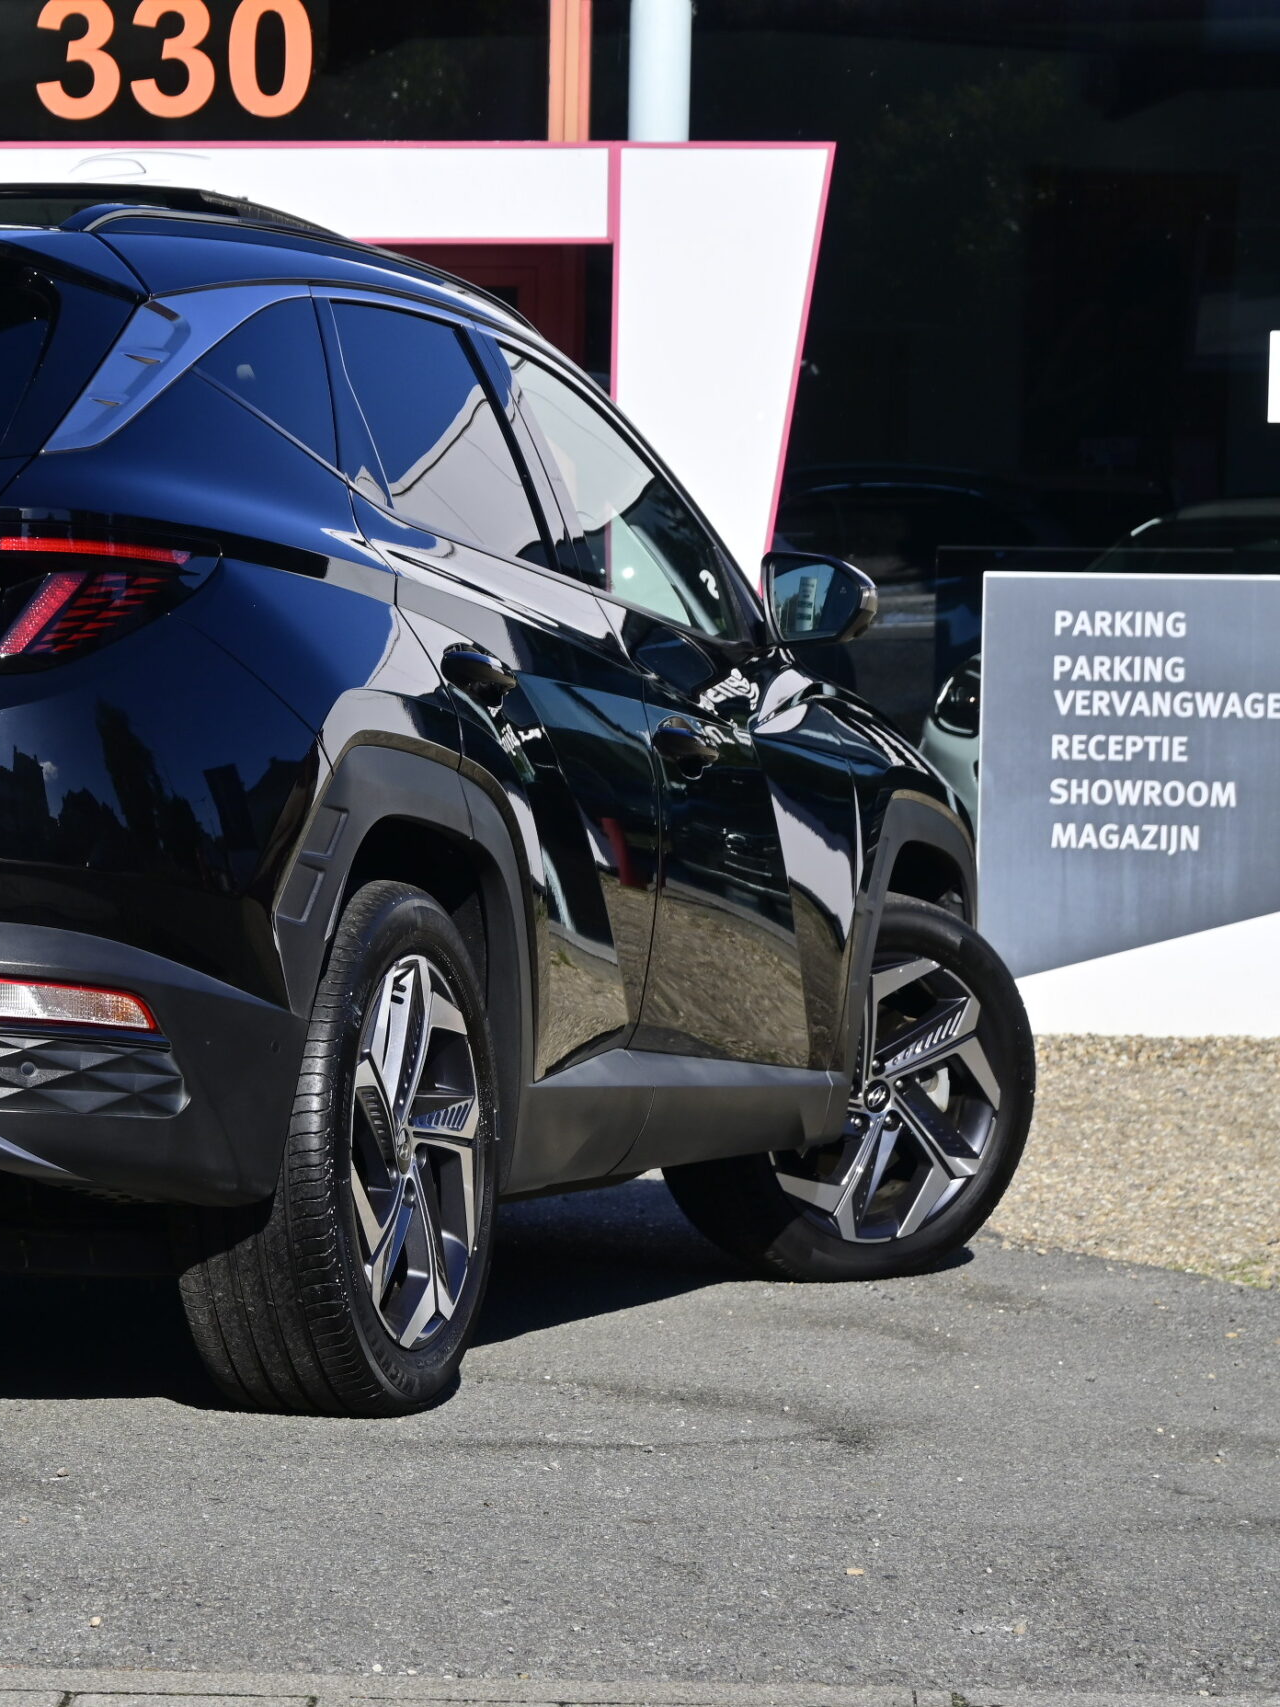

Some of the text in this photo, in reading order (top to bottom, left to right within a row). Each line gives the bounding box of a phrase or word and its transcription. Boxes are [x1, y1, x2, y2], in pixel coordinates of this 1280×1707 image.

[36, 0, 313, 120] 330
[1054, 610, 1187, 638] PARKING
[1053, 655, 1185, 683] PARKING
[1051, 734, 1188, 762] RECEPTIE
[1049, 778, 1237, 808] SHOWROOM
[1050, 822, 1200, 855] MAGAZIJN
